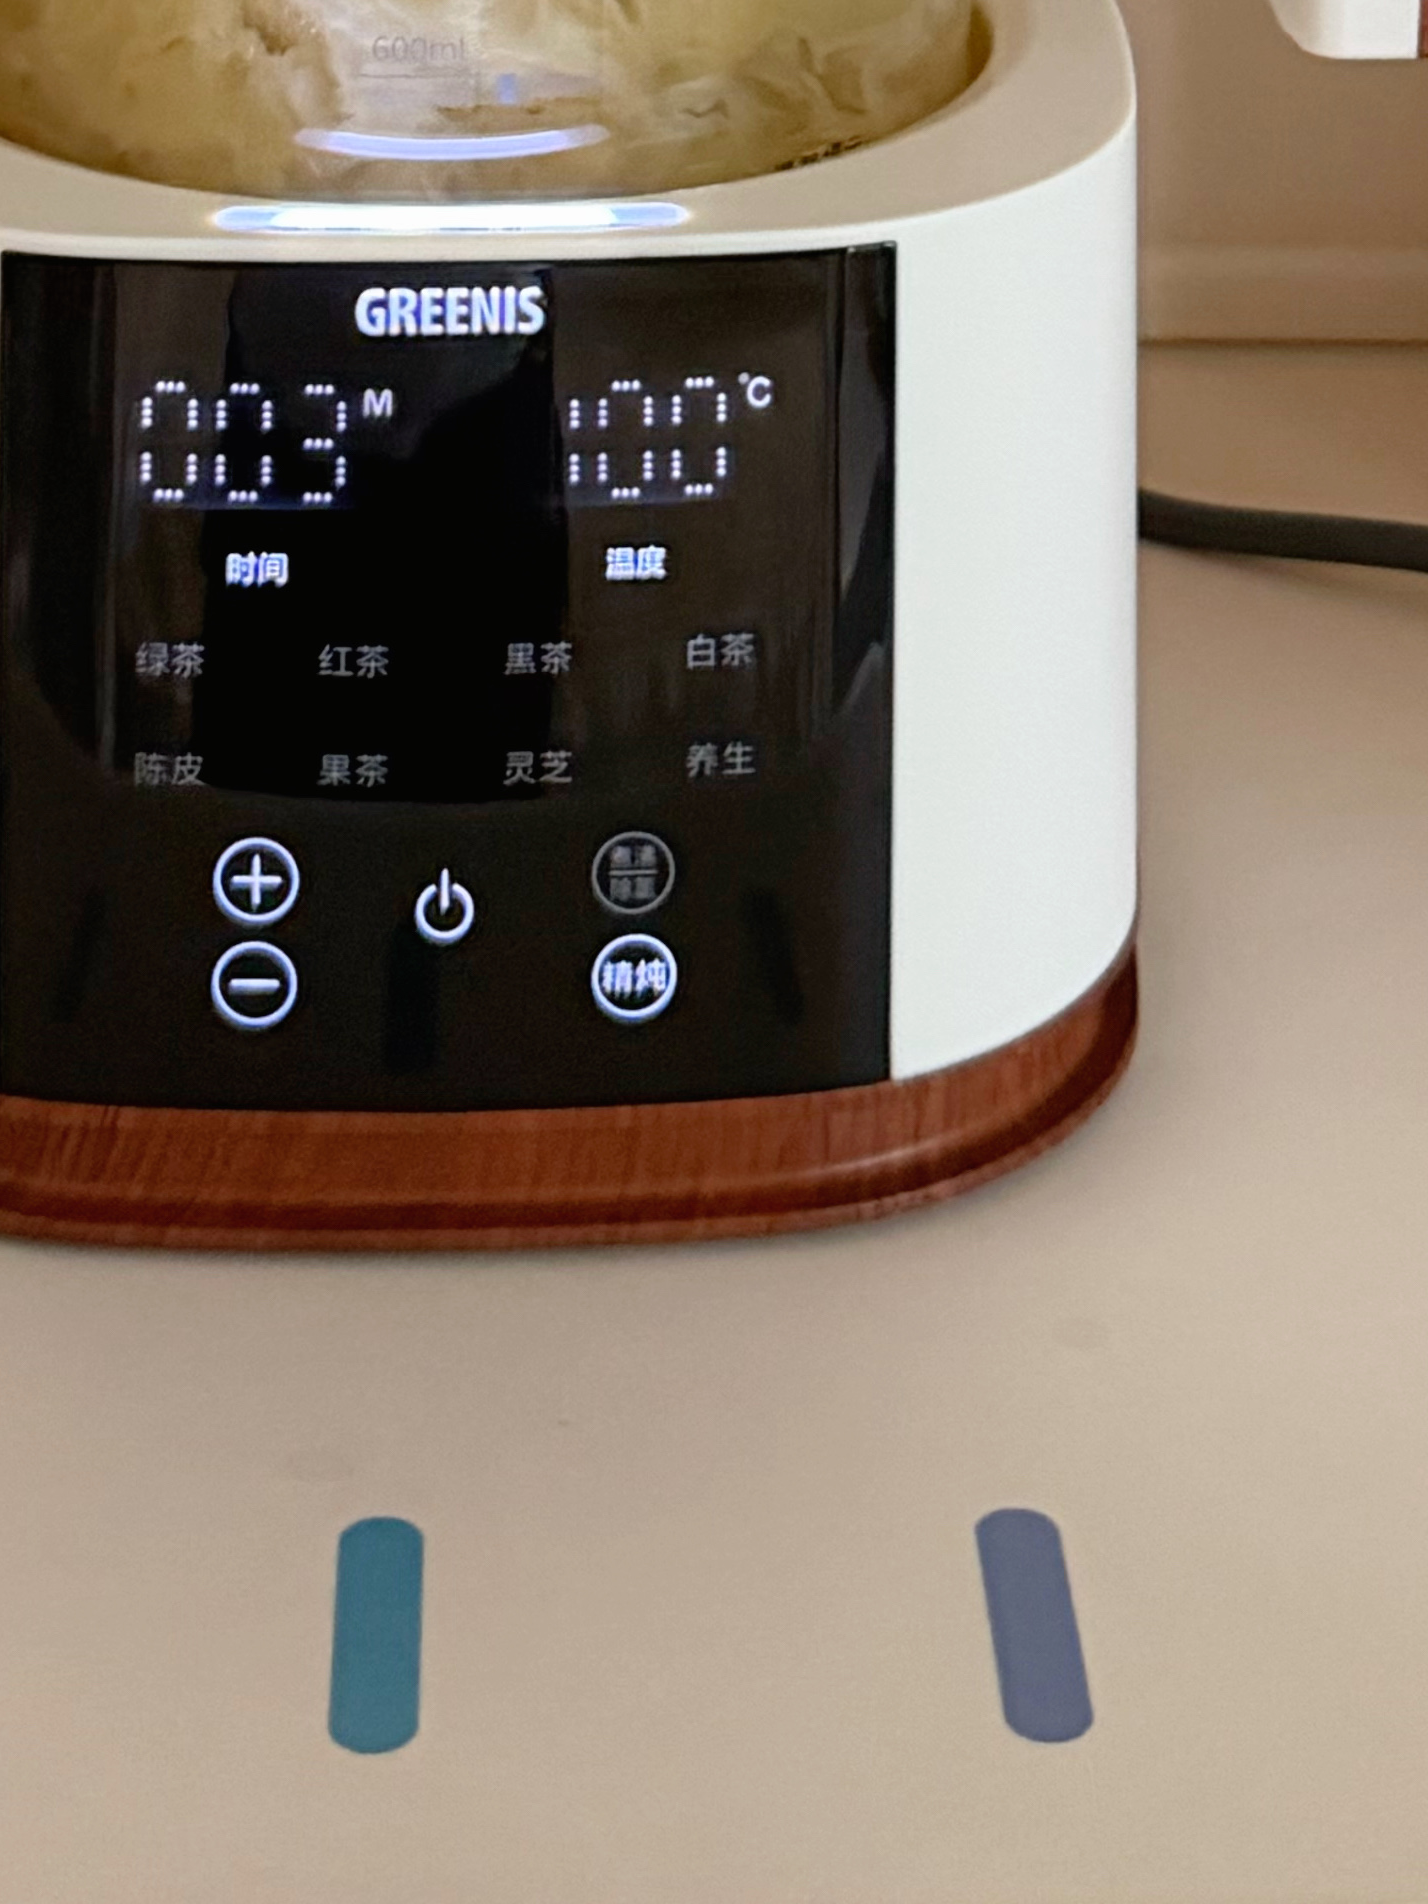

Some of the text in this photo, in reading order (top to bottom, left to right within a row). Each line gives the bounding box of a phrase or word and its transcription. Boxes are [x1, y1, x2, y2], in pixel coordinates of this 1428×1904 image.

[353, 285, 546, 337] GREENIS
[139, 380, 349, 504] 003
[225, 550, 290, 588] 时间
[605, 544, 668, 581] 温度
[135, 641, 205, 679] 绿茶
[317, 644, 390, 679] 红茶
[503, 641, 573, 678] 黑茶
[685, 632, 755, 670] 白茶
[133, 752, 205, 787] 陈皮
[316, 753, 389, 788] 果茶
[502, 750, 573, 787] 灵芝
[685, 740, 756, 780] 养生
